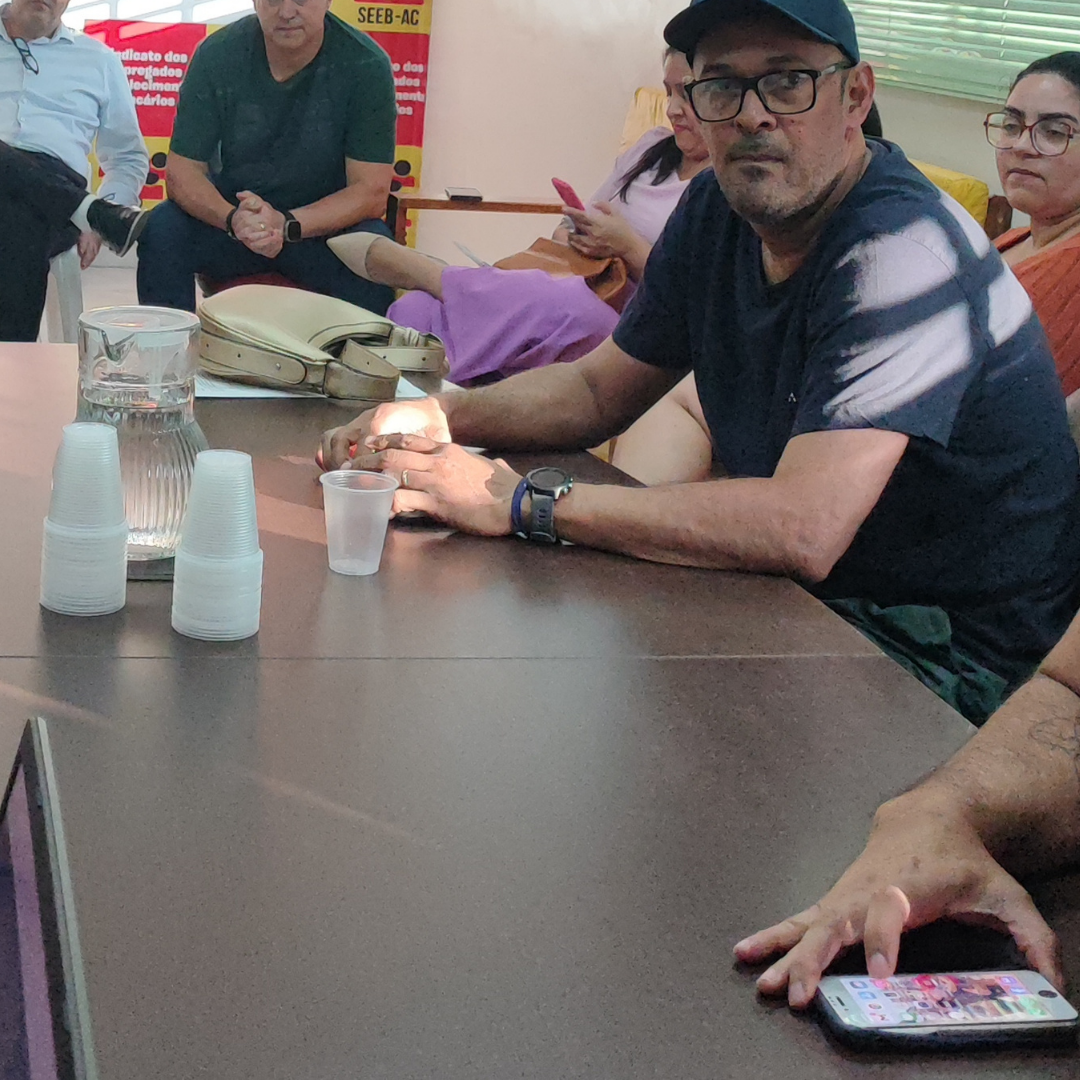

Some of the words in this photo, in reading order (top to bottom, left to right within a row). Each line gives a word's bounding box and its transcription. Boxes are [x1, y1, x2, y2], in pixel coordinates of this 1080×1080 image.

[357, 7, 420, 26] SEEB-AC
[164, 51, 188, 63] dos
[403, 60, 424, 73] dos
[136, 93, 176, 107] cários
